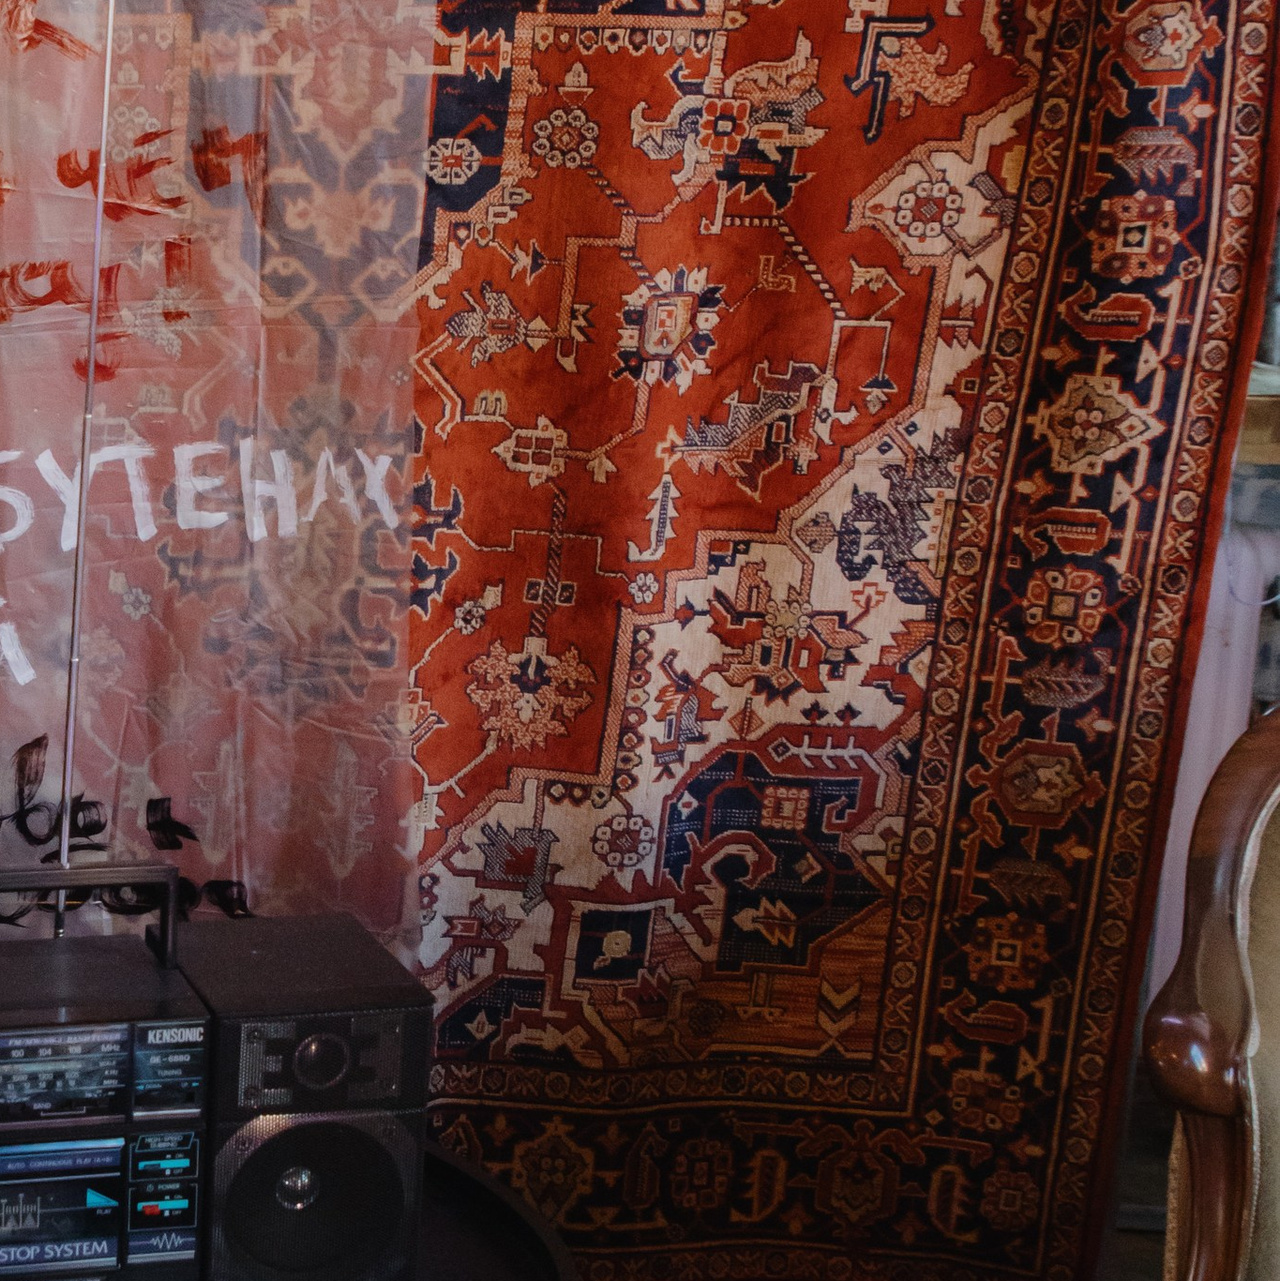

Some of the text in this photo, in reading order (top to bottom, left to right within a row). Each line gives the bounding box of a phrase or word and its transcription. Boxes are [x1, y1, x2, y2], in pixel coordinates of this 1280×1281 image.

[147, 1027, 204, 1044] KENSONIC
[11, 1048, 25, 1058] 100
[44, 1240, 109, 1259] SYSTEM
